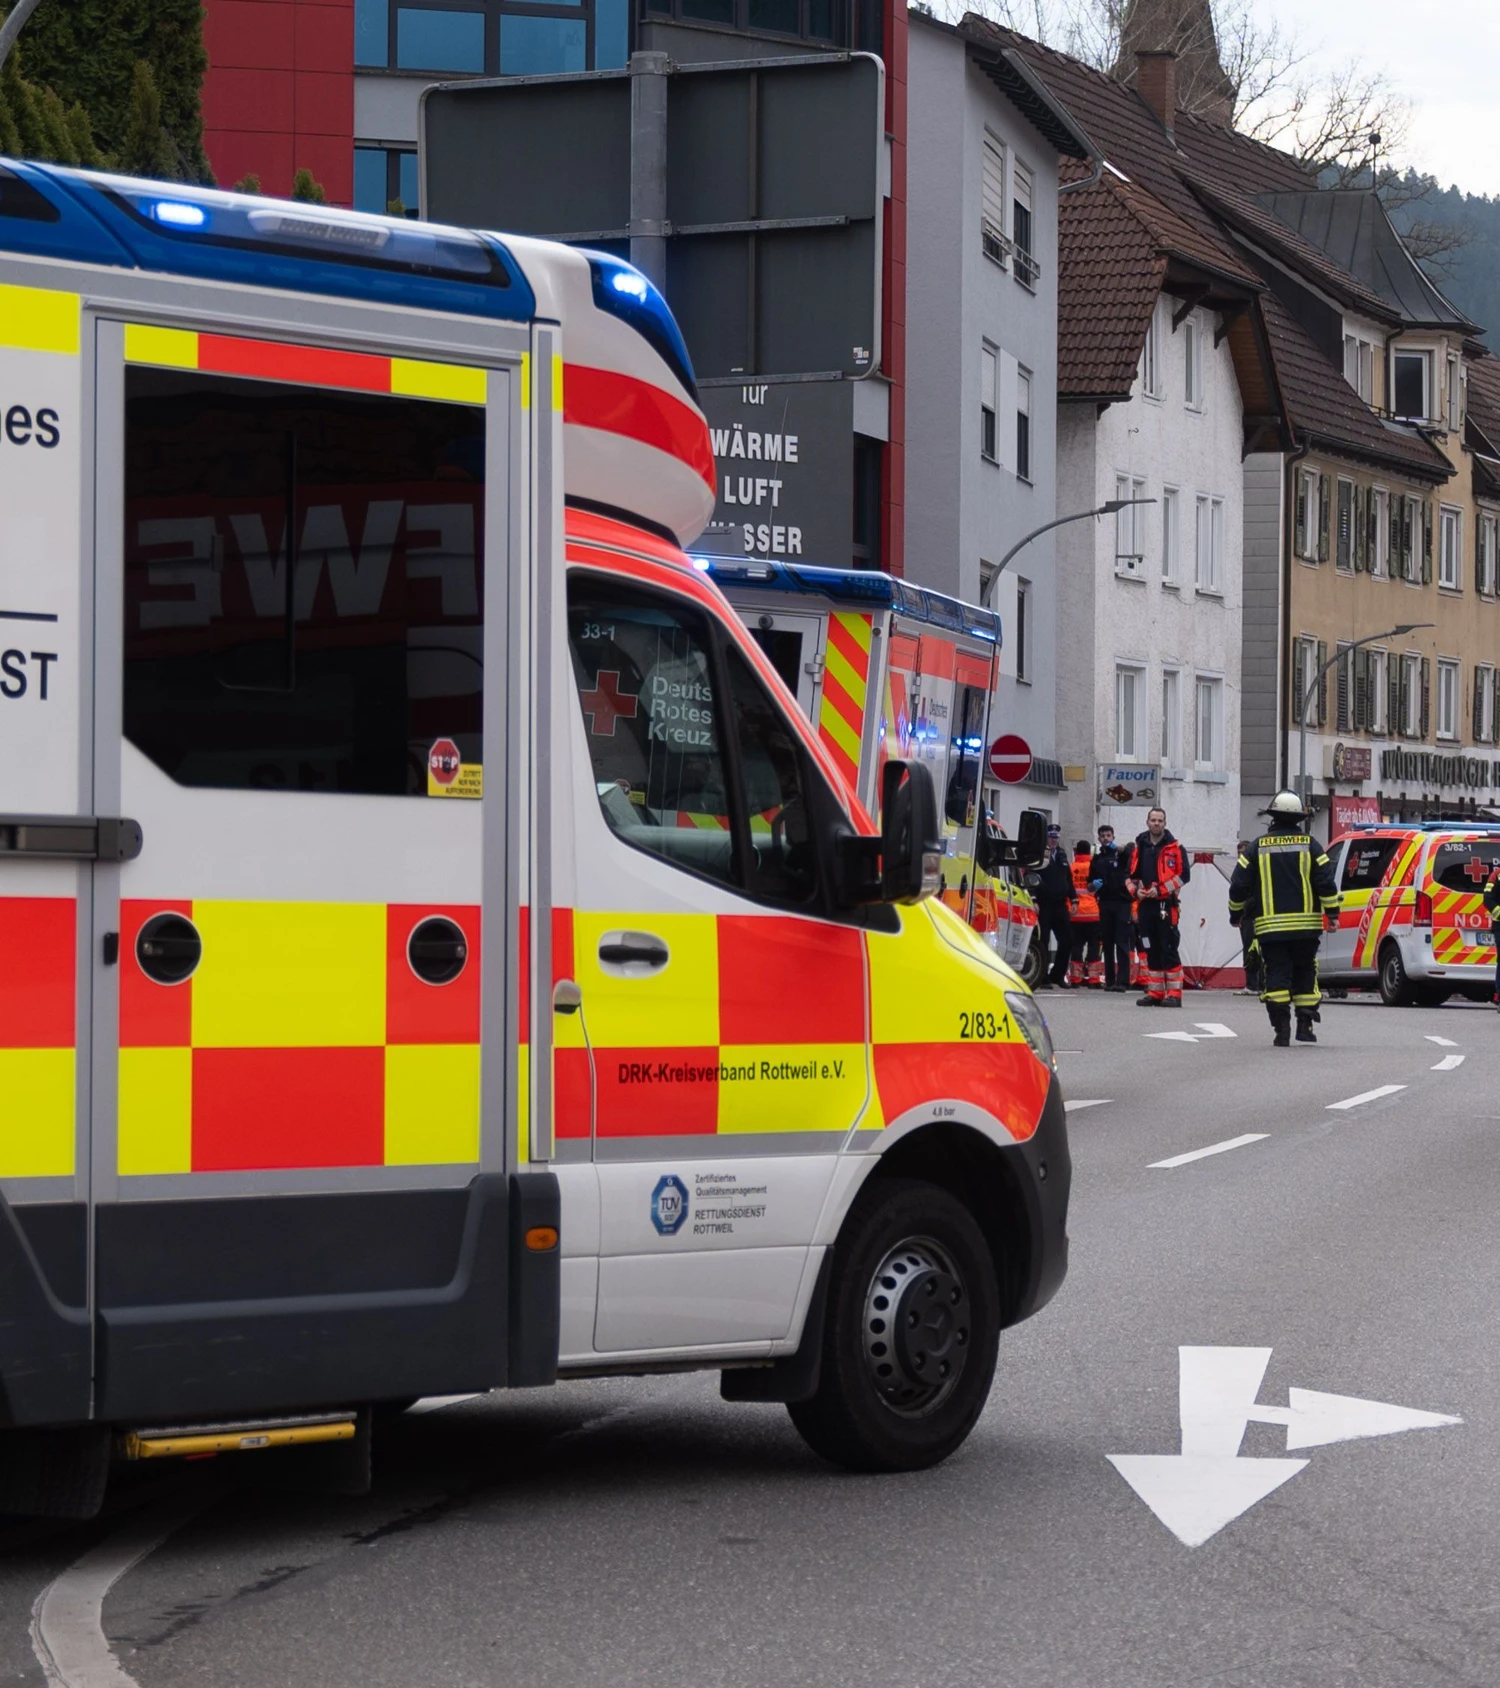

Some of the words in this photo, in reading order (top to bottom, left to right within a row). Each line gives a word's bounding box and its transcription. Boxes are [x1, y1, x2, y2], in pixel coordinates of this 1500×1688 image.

[0, 405, 60, 449] es
[709, 423, 798, 463] WÄRME
[724, 476, 782, 507] LUFT
[707, 521, 802, 555] SSER
[651, 699, 713, 725] Rotes
[648, 721, 712, 746] Kreuz
[1106, 768, 1156, 781] Favori
[1444, 843, 1472, 852] 3/82-1
[960, 1012, 1011, 1040] 2/83-1
[618, 1062, 756, 1084] DRK-Kreisverband
[760, 1060, 817, 1081] Rottweil
[821, 1060, 845, 1079] e.V.
[695, 1206, 766, 1220] RETTUNGSDIENST
[693, 1223, 735, 1235] ROTTWEIL
